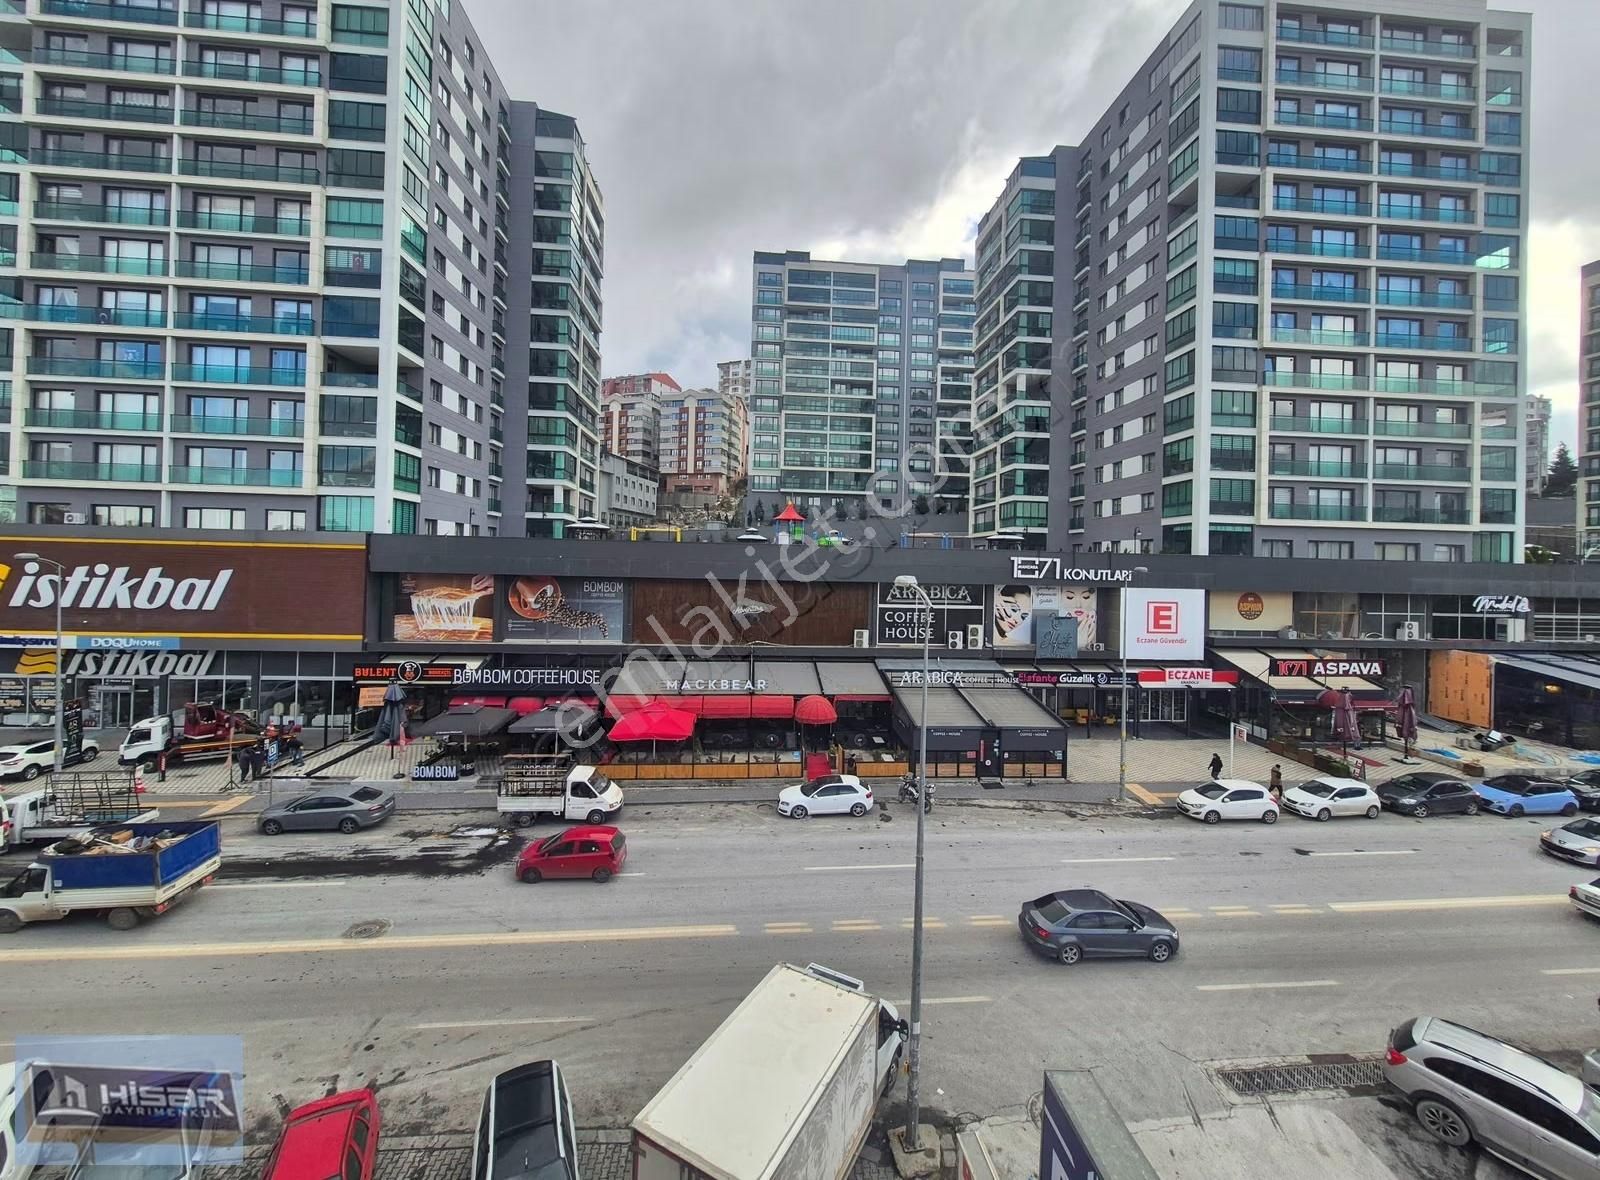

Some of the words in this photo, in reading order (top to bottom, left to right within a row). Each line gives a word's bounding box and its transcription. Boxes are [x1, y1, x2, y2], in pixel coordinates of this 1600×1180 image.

[8, 561, 234, 611] istikbal
[884, 611, 936, 623] COFFEE
[1153, 605, 1172, 630] E
[1312, 662, 1382, 675] ASPAVA
[1059, 673, 1095, 684] Güzellik
[1168, 670, 1211, 680] ECZANE
[666, 679, 767, 690] MACKBEAR
